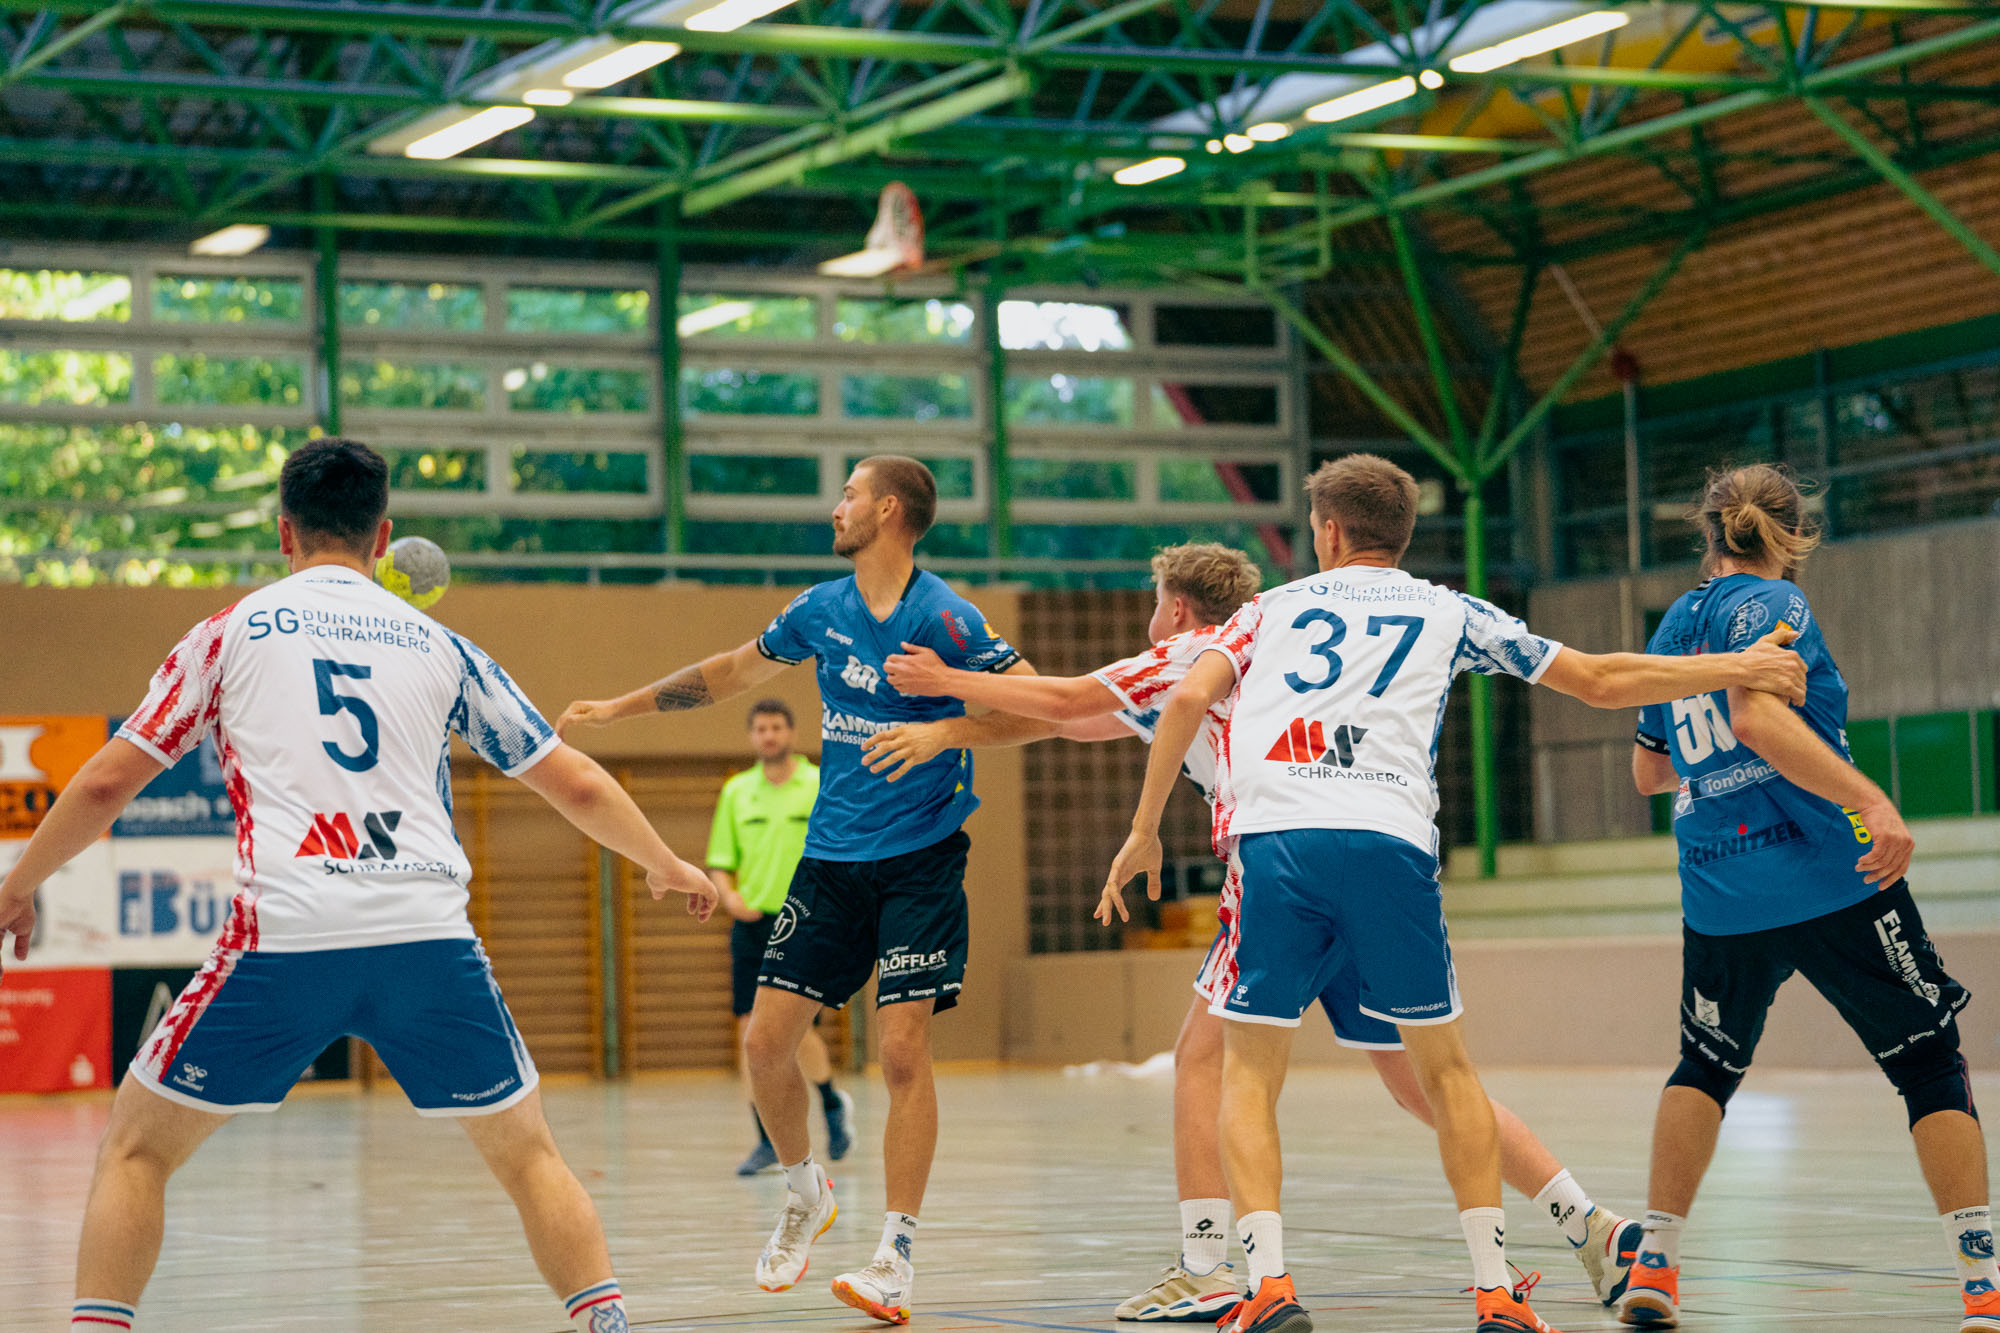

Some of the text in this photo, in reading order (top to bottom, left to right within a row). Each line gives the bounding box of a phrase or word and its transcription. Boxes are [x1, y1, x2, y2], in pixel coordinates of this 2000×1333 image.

[248, 607, 430, 640] SG DUNNINGEN
[940, 609, 969, 652] SCHAAL
[304, 623, 431, 654] SCHRAMBERG
[825, 627, 853, 646] Kempa
[1284, 608, 1425, 698] 37
[312, 658, 379, 772] 5
[1287, 766, 1408, 787] SCHRAMBERG
[884, 949, 947, 972] LÖFFLER
[772, 976, 799, 990] Kempa
[908, 988, 936, 997] Kempa
[1908, 1029, 1935, 1044] Kempa
[1878, 1044, 1904, 1059] Kempa
[1185, 1232, 1224, 1240] LOTTO
